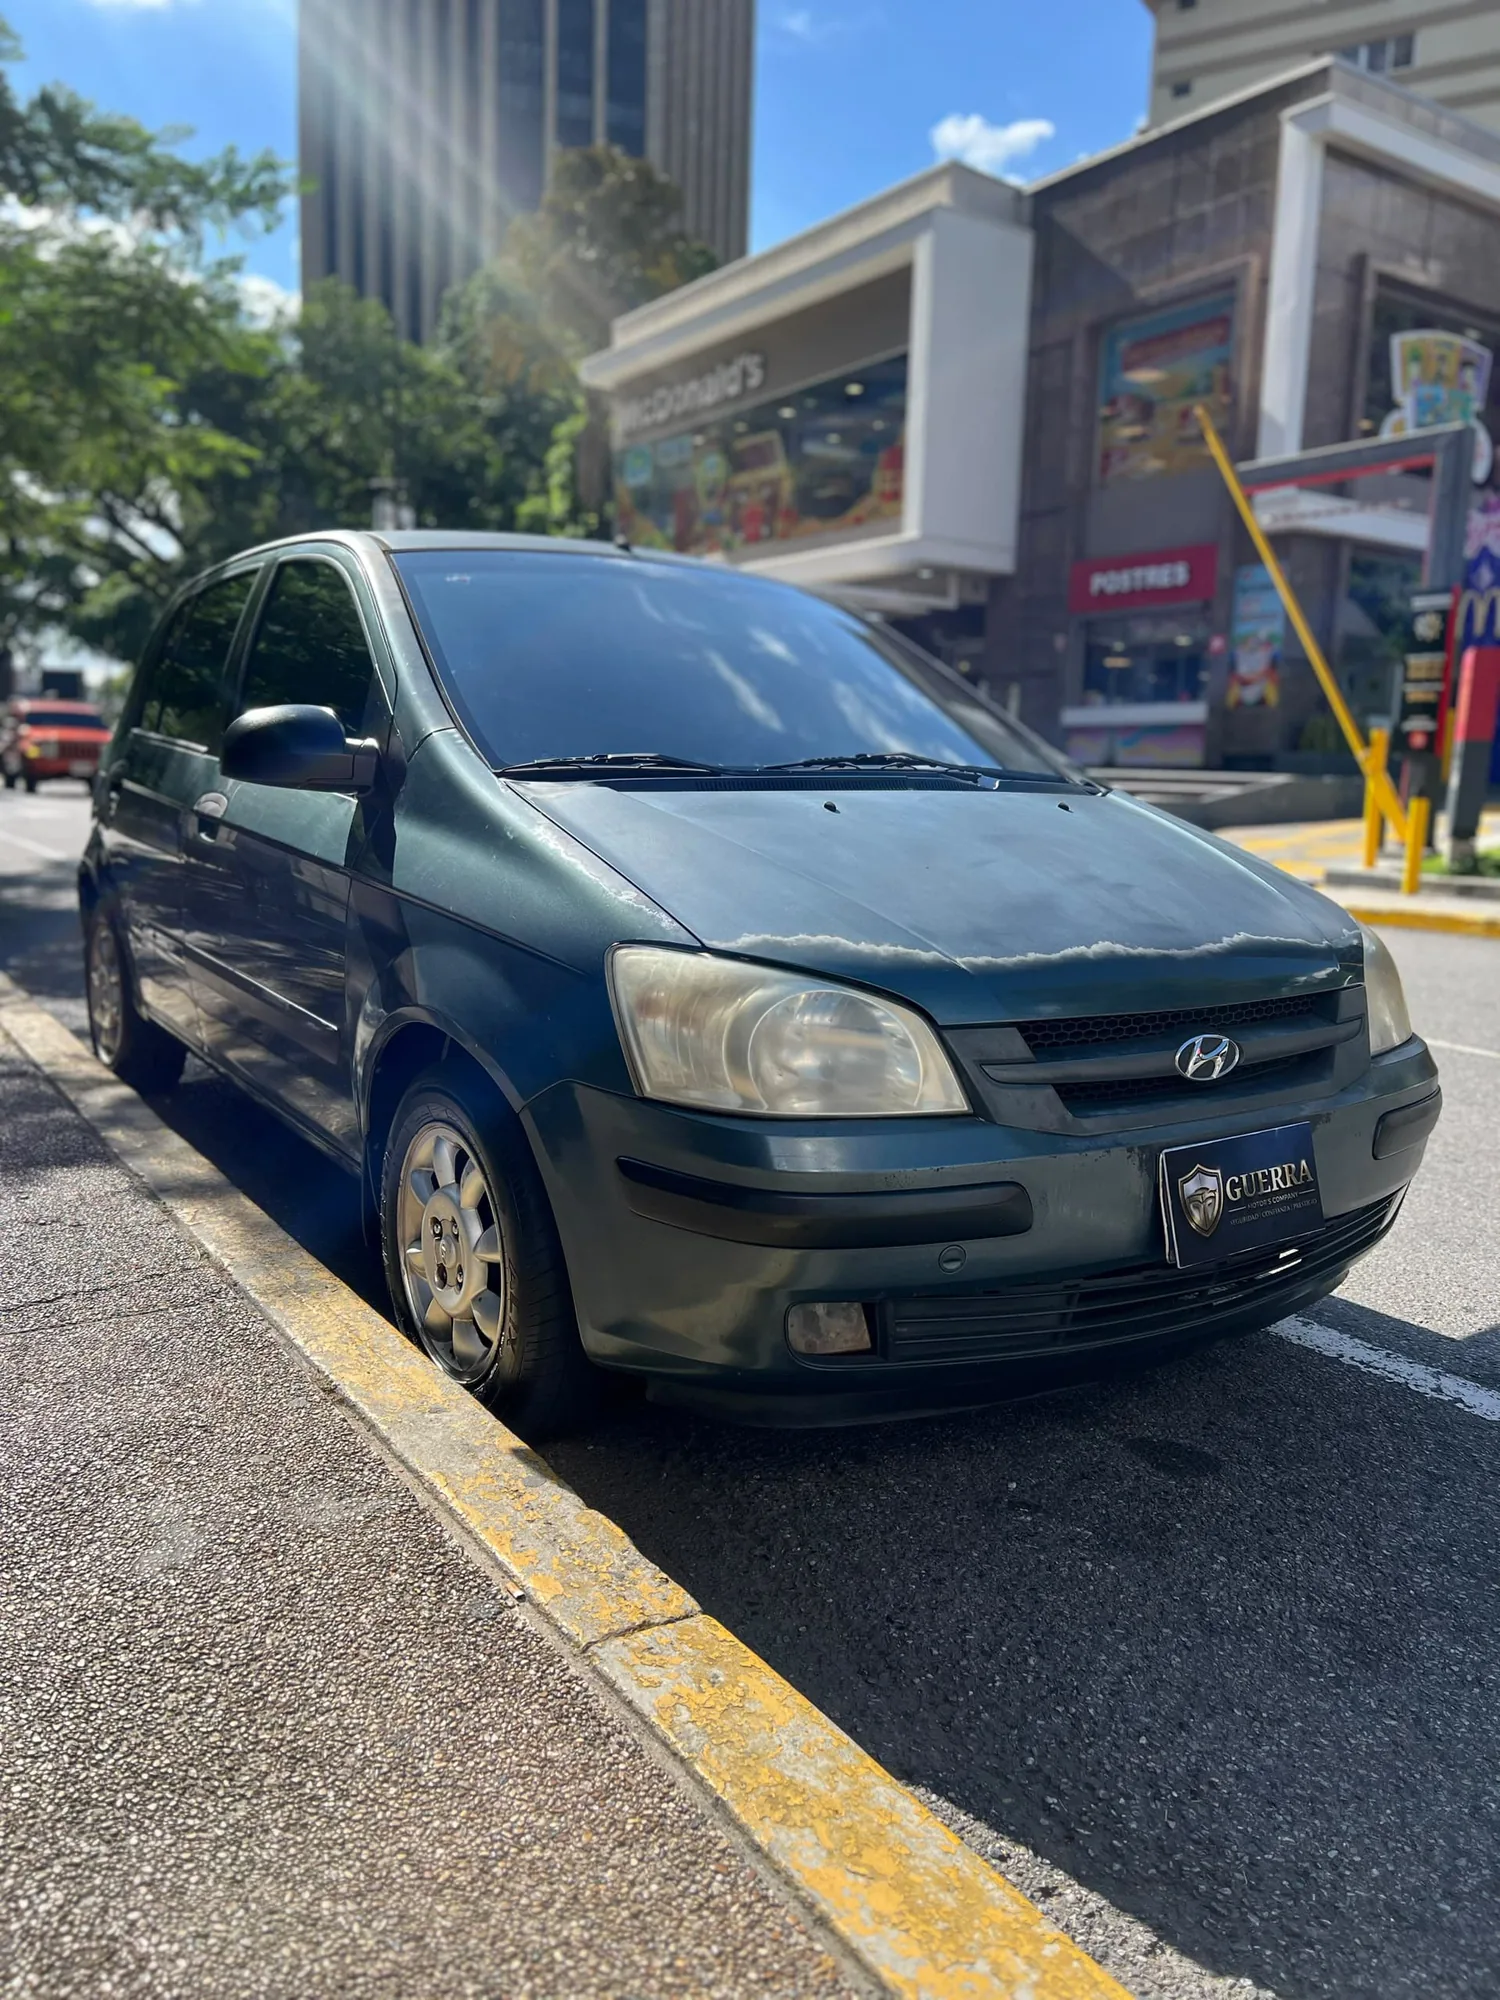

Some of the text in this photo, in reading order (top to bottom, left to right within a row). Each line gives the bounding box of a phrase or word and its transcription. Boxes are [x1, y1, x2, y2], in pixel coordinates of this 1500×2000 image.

[1089, 560, 1191, 597] POSTRES
[1225, 1159, 1314, 1201] GUERRA
[1272, 1192, 1299, 1204] COMPANY
[1261, 1205, 1291, 1218] CONFIANZA
